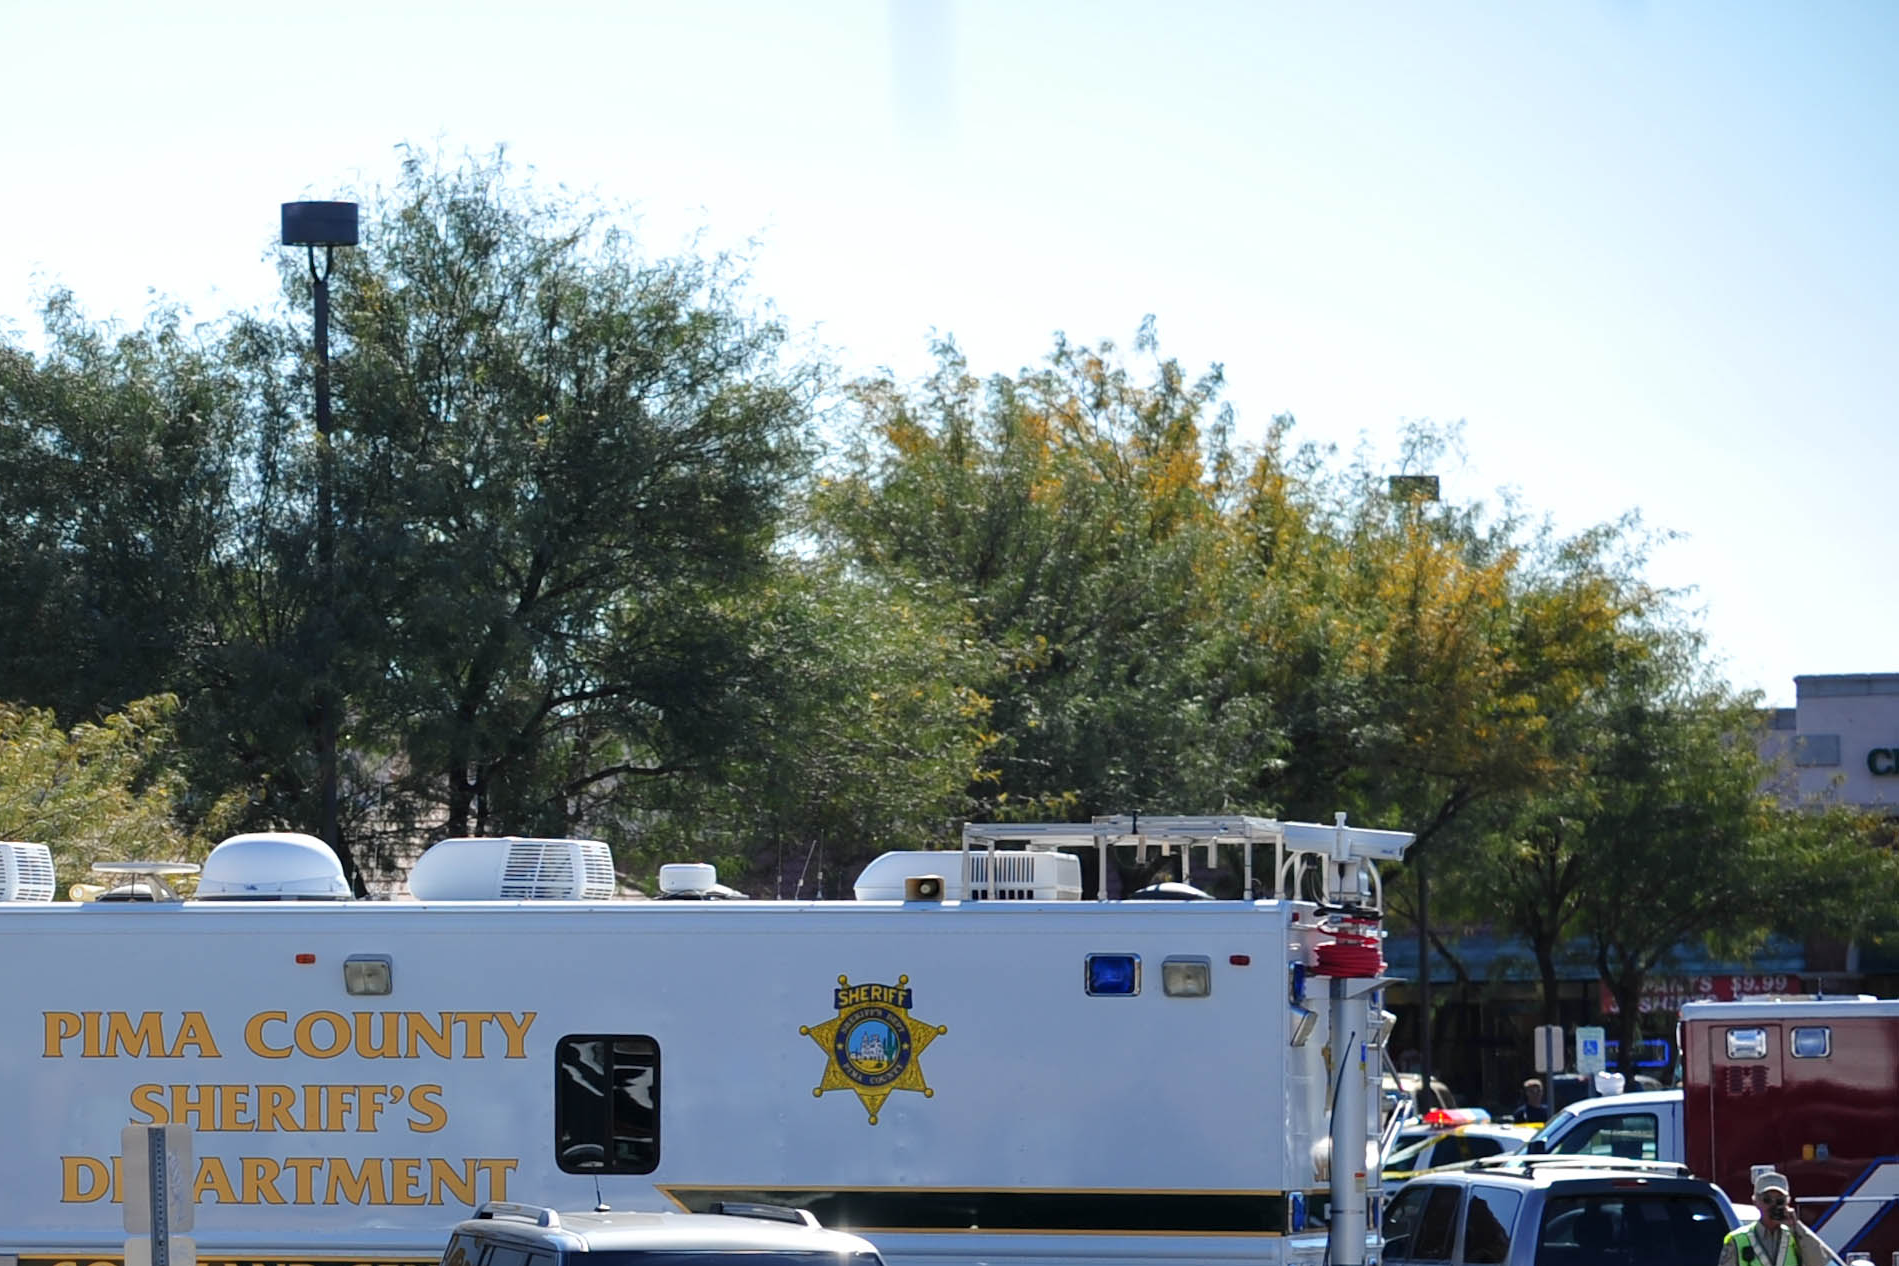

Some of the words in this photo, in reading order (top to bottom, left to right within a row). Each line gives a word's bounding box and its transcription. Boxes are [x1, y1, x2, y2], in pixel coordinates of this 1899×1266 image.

[838, 984, 908, 1007] SHERIFF
[1730, 976, 1788, 994] $9.99
[42, 1011, 222, 1058] PIMA
[244, 1010, 537, 1059] COUNTY
[129, 1083, 449, 1132] SHERIFF'S
[60, 1156, 519, 1207] DARTMENT
